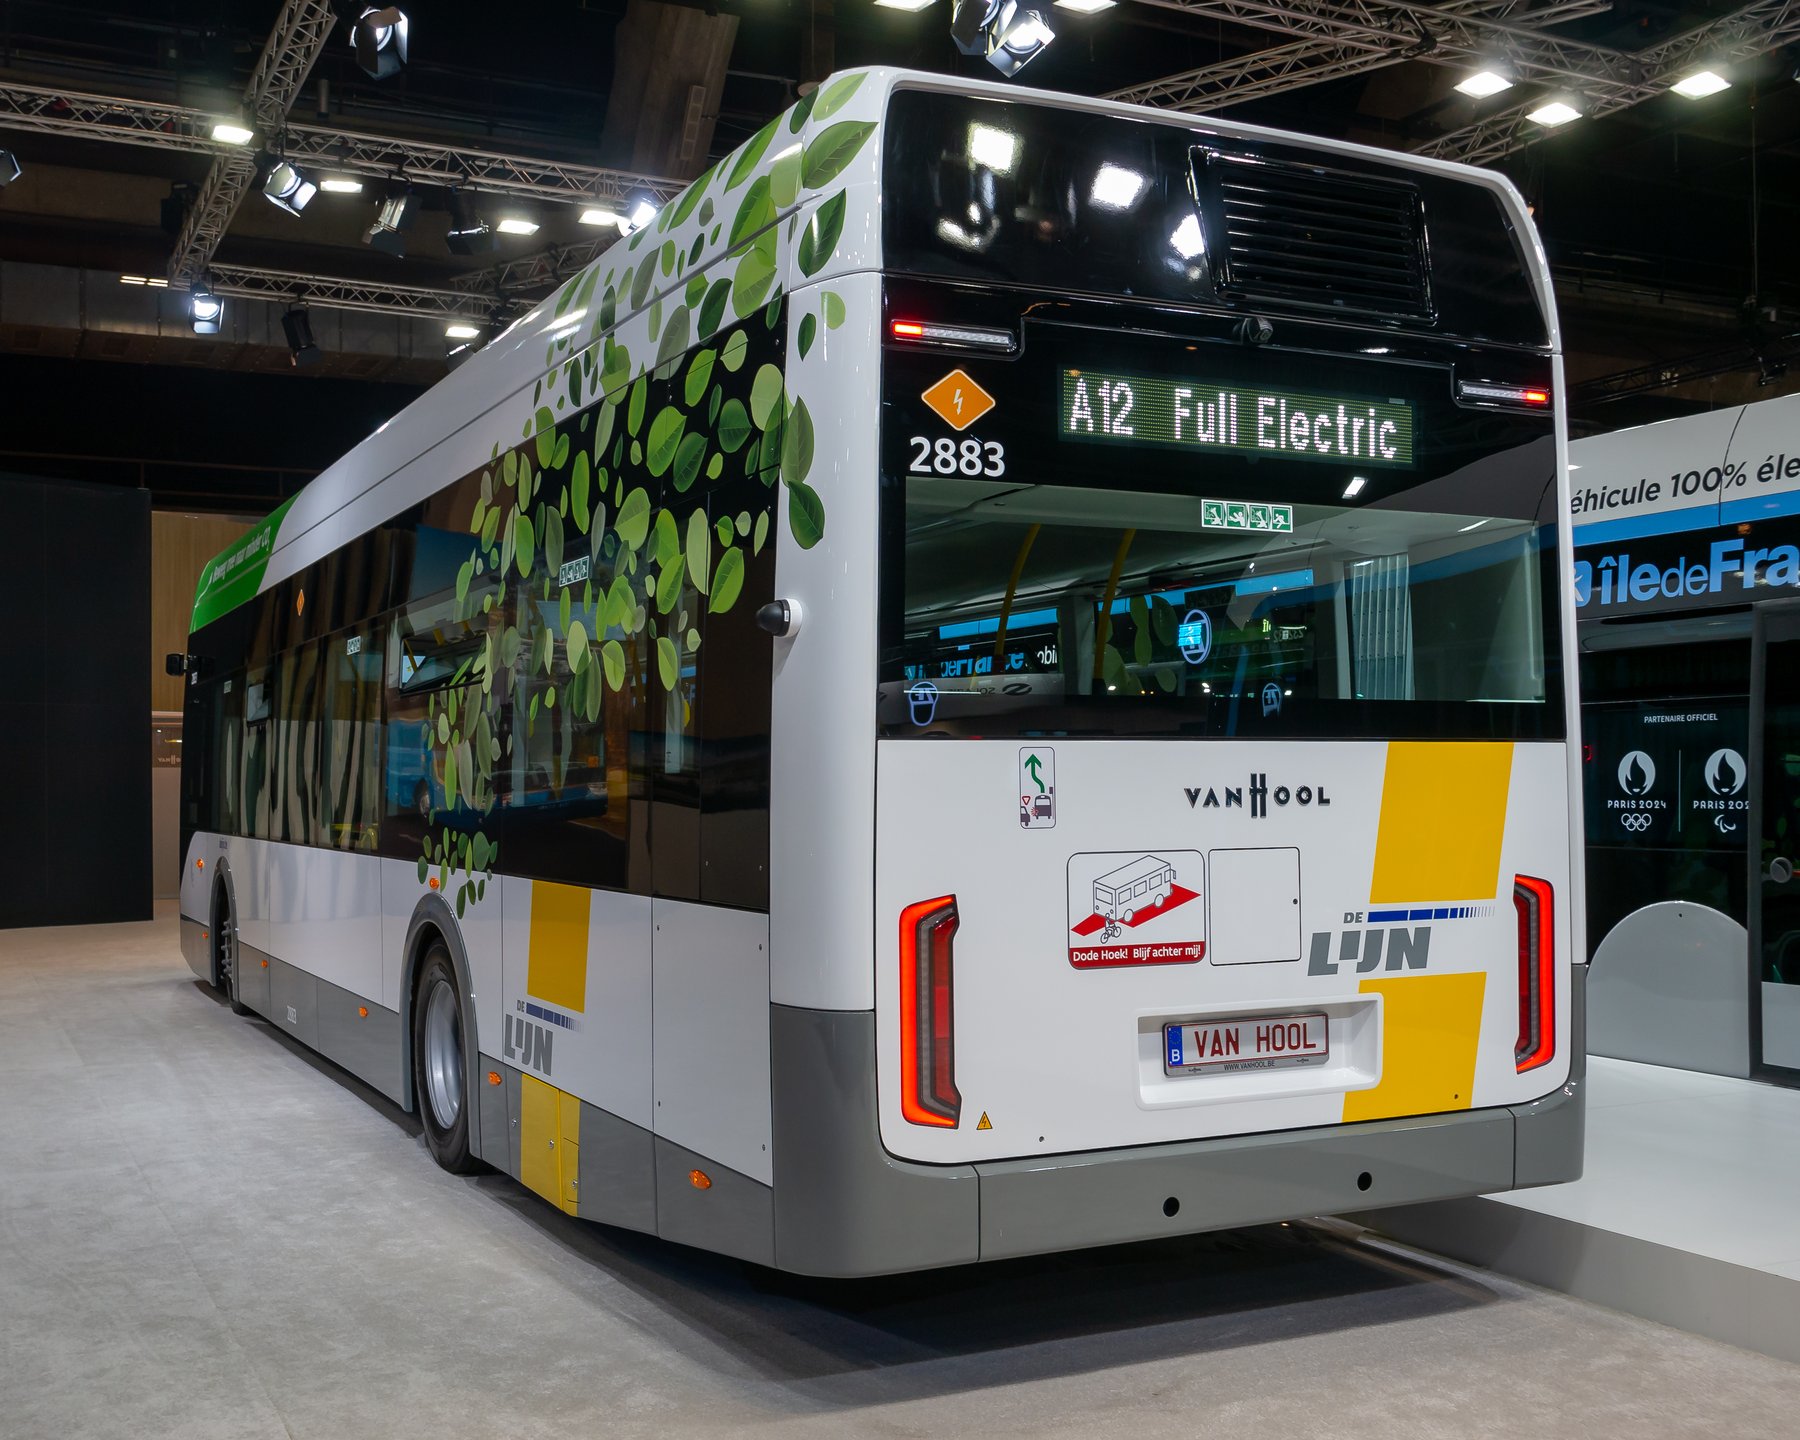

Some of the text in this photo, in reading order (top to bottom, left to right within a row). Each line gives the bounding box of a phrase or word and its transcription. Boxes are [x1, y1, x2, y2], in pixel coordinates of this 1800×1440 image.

[1070, 378, 1398, 459] A12 Full Electric
[909, 436, 1006, 477] 2883
[1671, 461, 1748, 498] 100%
[1644, 713, 1718, 723] PARTENAIRE OFFICIEL
[1639, 800, 1666, 809] 2024
[1344, 912, 1364, 924] DE
[1073, 944, 1201, 962] Dode Hoek! Blijf achter mij!
[1307, 926, 1432, 976] LIJN
[516, 1000, 525, 1012] DE
[504, 1014, 554, 1076] LIJN
[1171, 1022, 1316, 1062] B VAN HOOL
[1224, 1060, 1276, 1071] WWW.VANHOOL.BE
